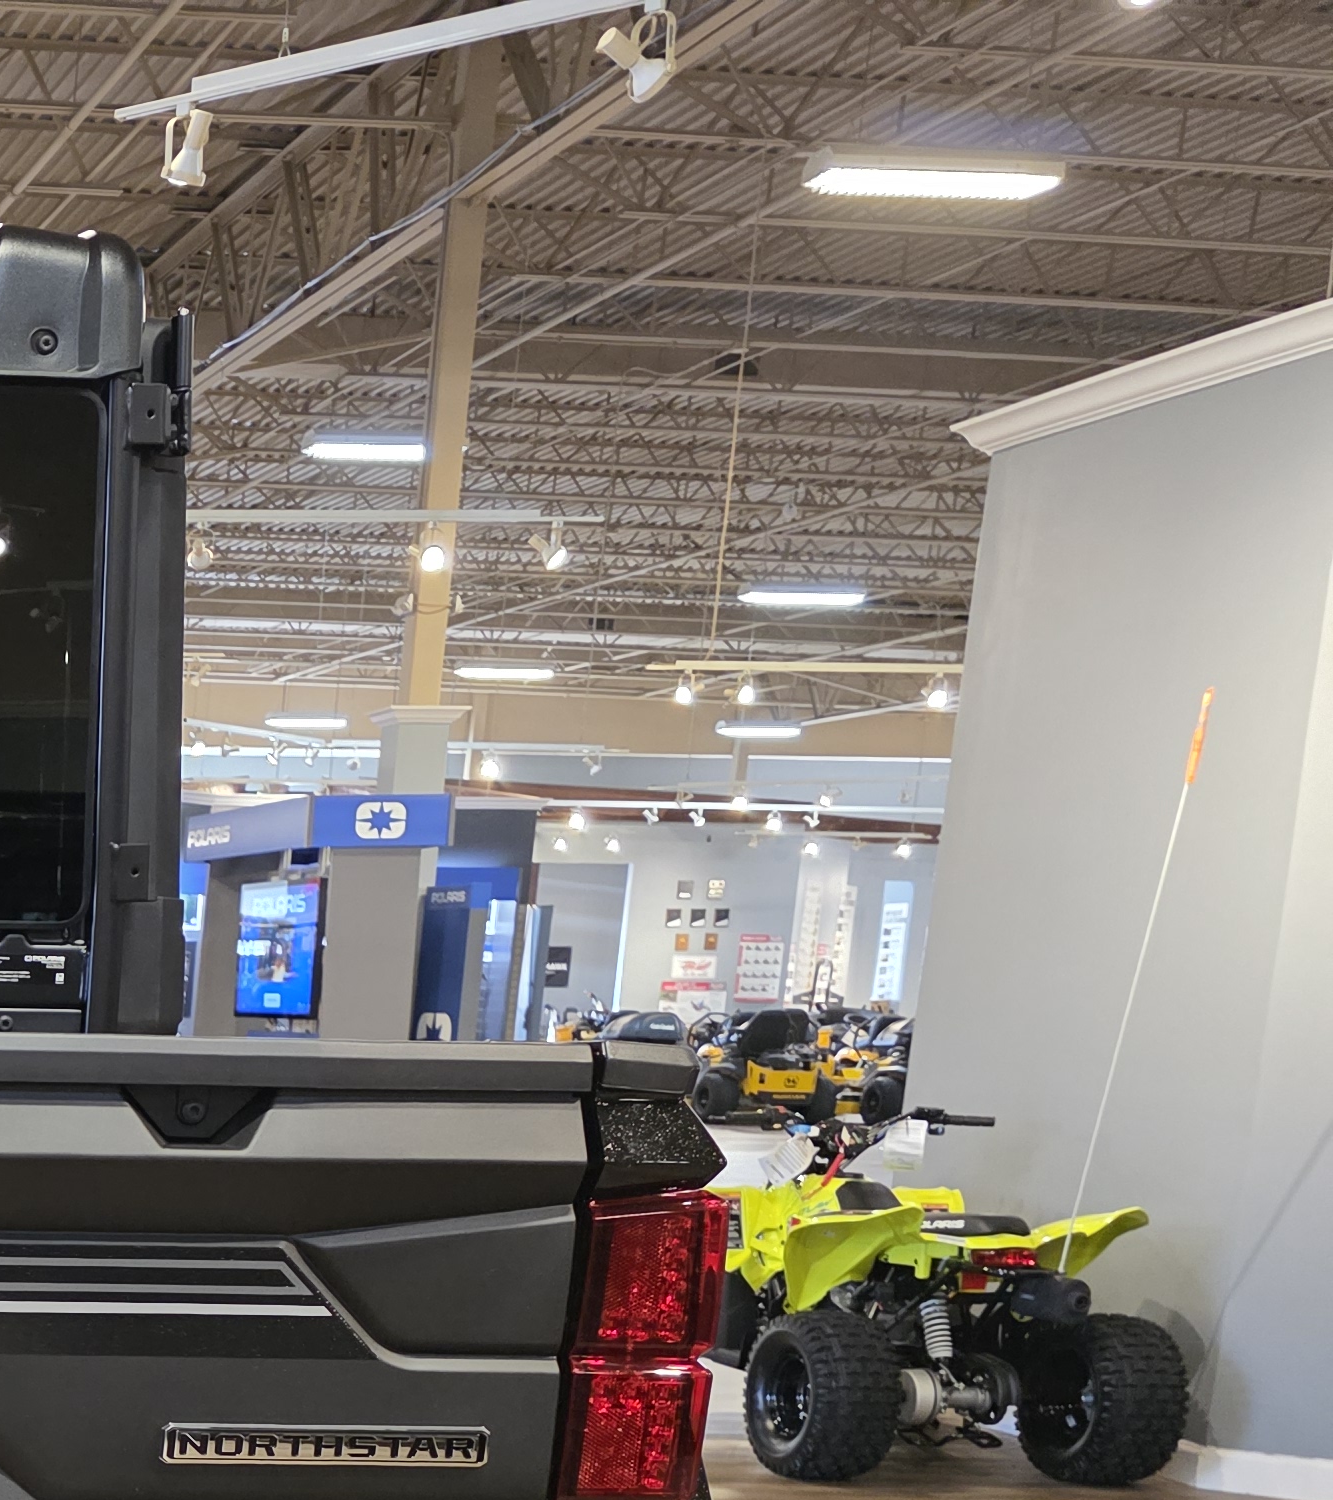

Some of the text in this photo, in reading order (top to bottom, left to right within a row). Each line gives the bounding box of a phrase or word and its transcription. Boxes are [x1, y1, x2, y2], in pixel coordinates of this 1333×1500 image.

[187, 825, 231, 848] POLARIS
[431, 890, 466, 903] POLARIS
[178, 1432, 475, 1459] NORTHSTAR
